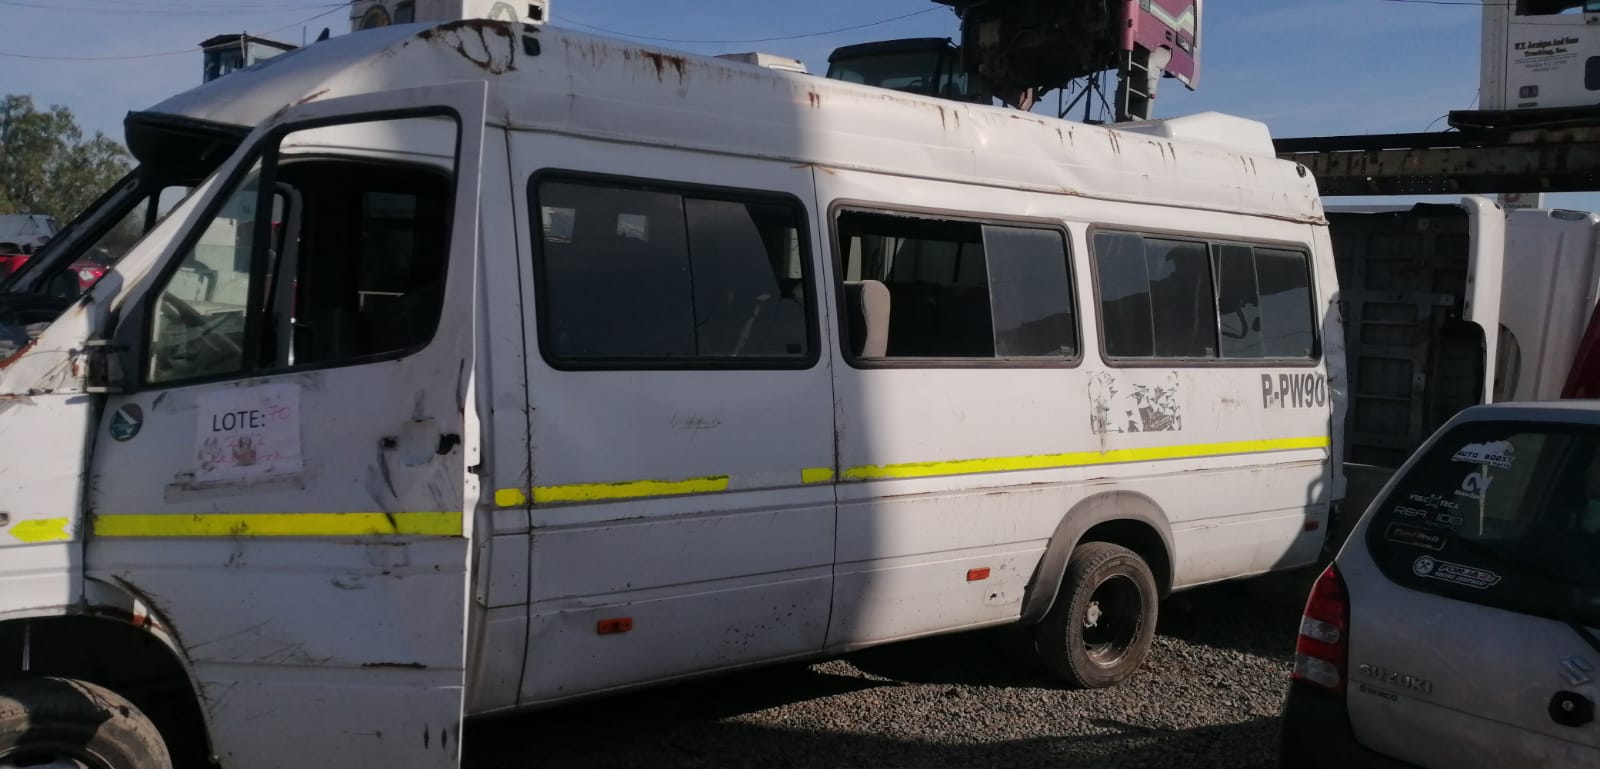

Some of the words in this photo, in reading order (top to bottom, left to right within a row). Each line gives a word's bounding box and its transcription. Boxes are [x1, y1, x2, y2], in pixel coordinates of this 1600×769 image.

[212, 409, 266, 432] LOTE:
[1456, 450, 1480, 459] AUTO
[1484, 453, 1513, 463] BOOST
[1359, 663, 1433, 695] SUZUKI
